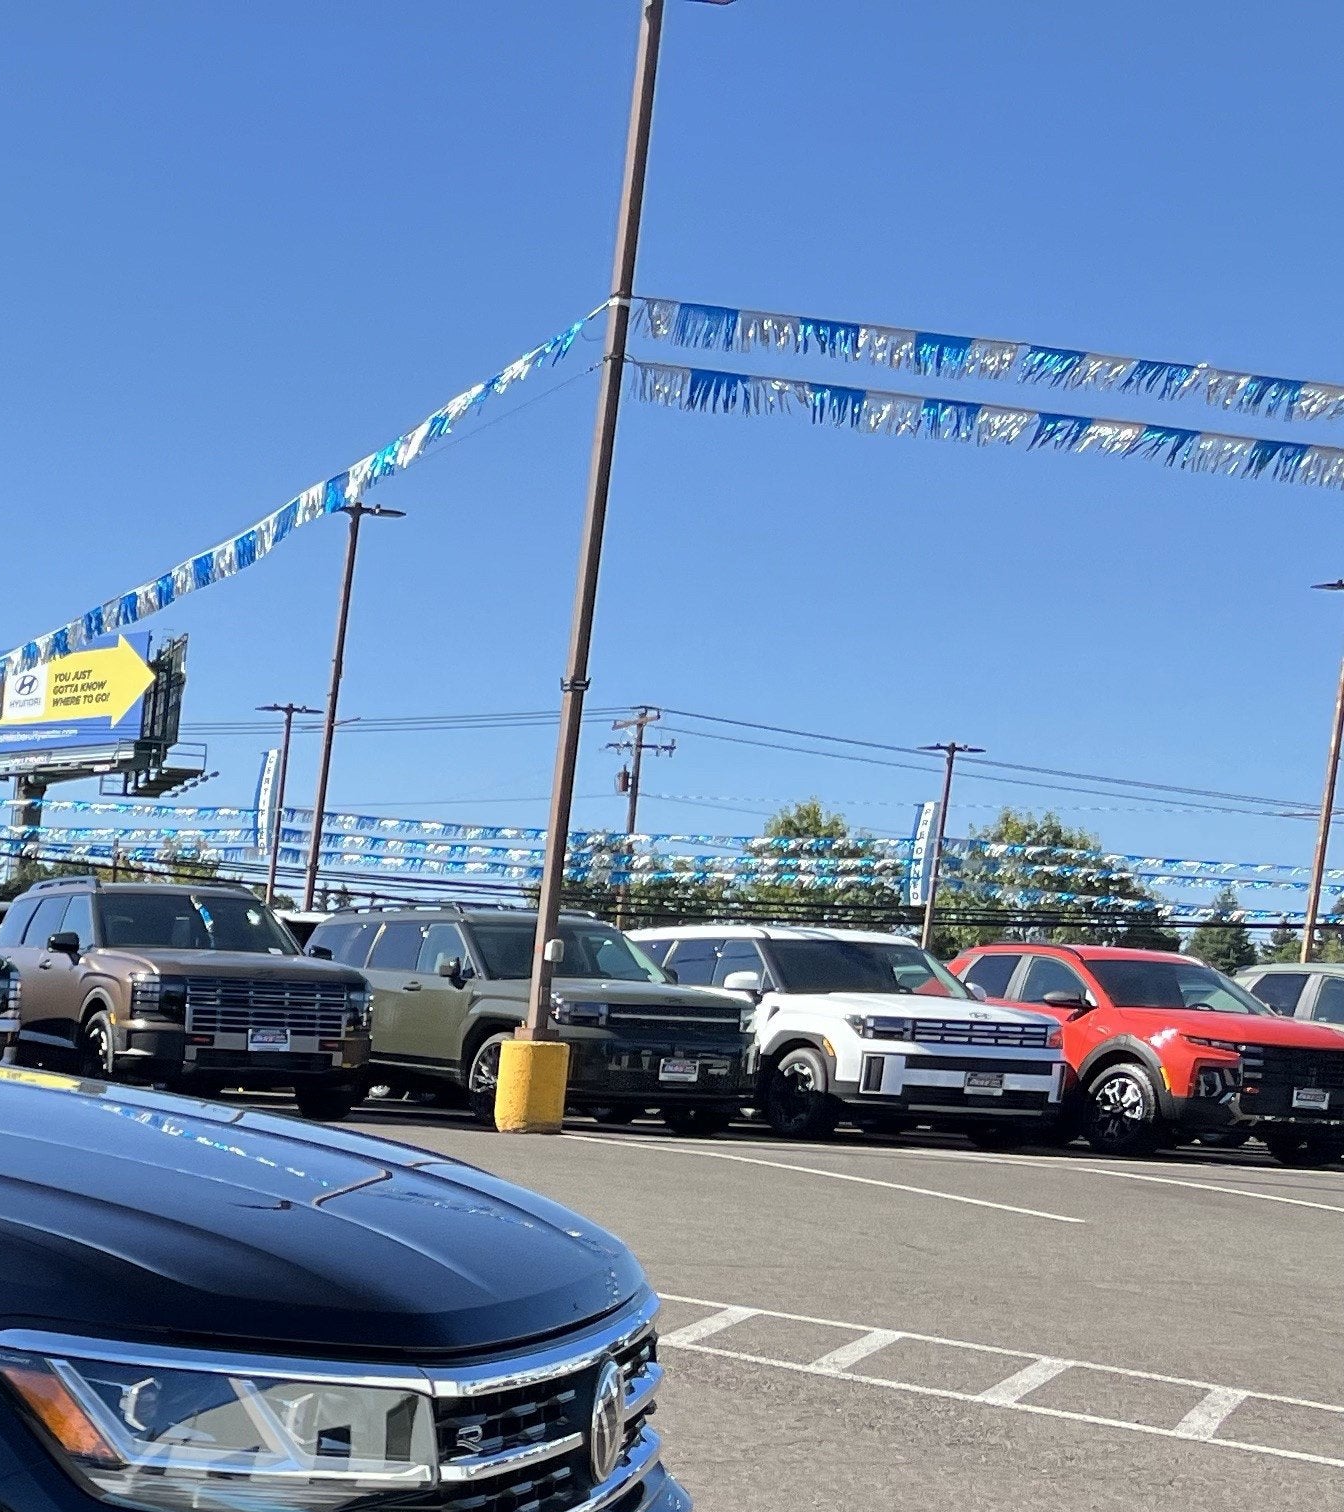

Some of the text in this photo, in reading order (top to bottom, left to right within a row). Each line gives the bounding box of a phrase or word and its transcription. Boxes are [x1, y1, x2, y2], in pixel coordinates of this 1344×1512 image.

[54, 669, 93, 683] YOU JUST
[52, 680, 108, 695] GOTTA KNOW
[52, 692, 111, 707] WHERE TO GO!
